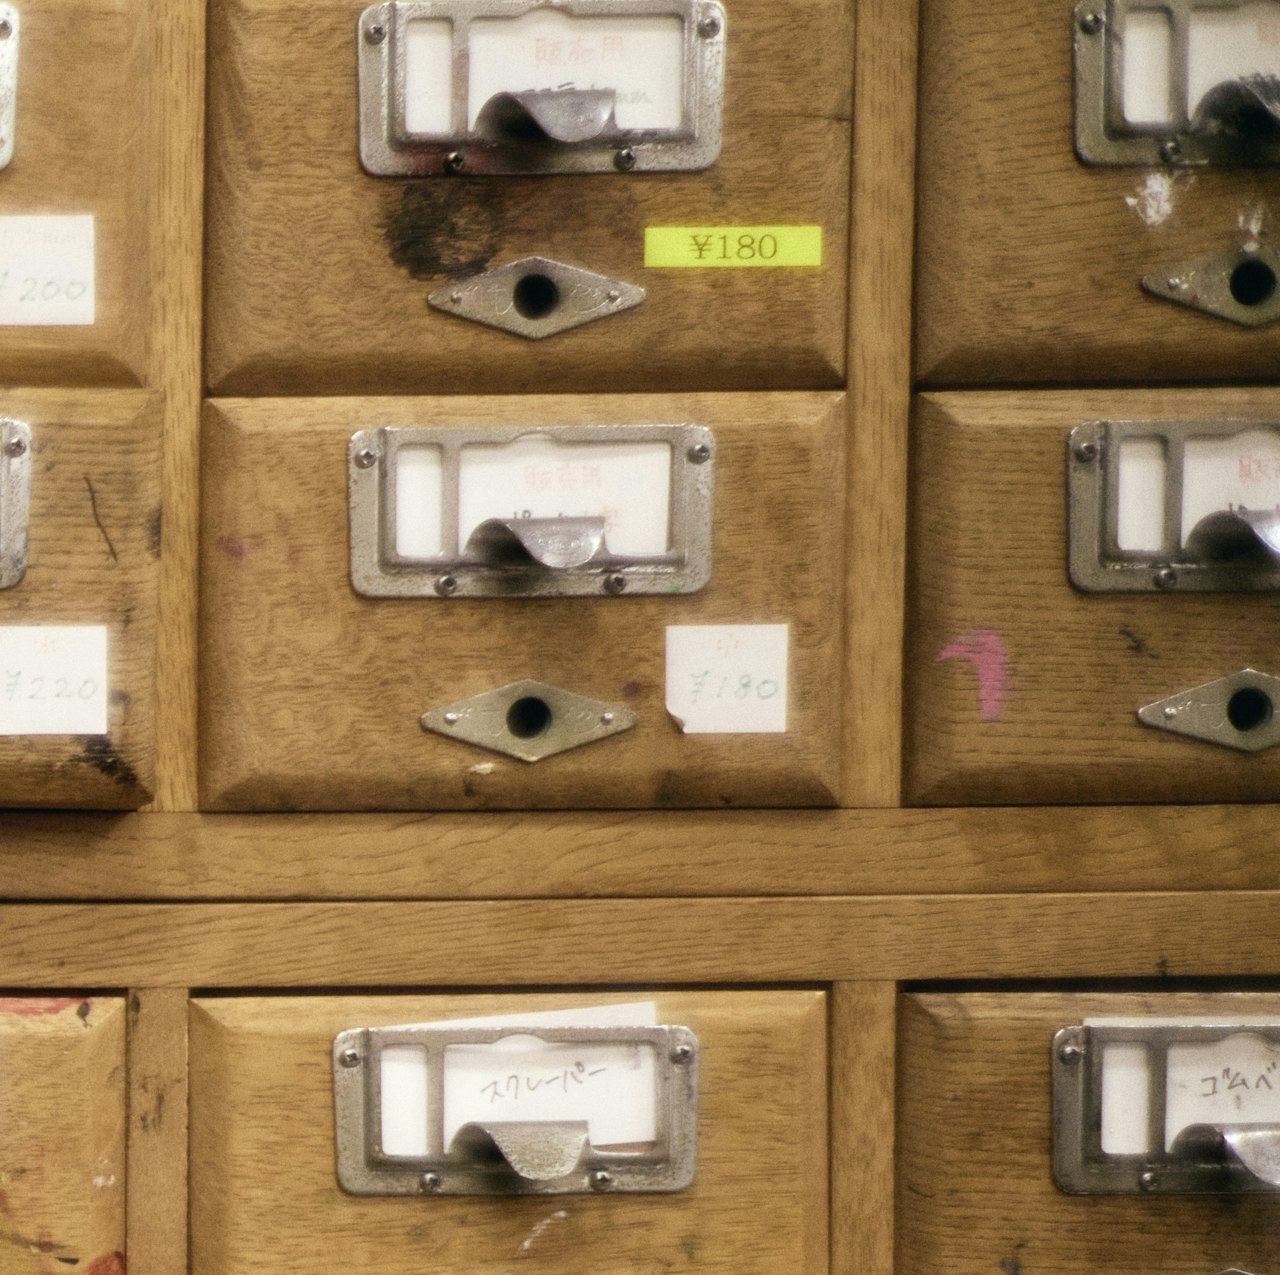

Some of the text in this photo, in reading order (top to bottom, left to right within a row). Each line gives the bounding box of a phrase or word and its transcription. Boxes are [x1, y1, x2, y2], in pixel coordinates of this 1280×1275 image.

[688, 231, 780, 262] ¥180
[4, 668, 99, 703] ¥220
[689, 669, 781, 705] ¥180
[479, 1060, 608, 1104] スクレーパー
